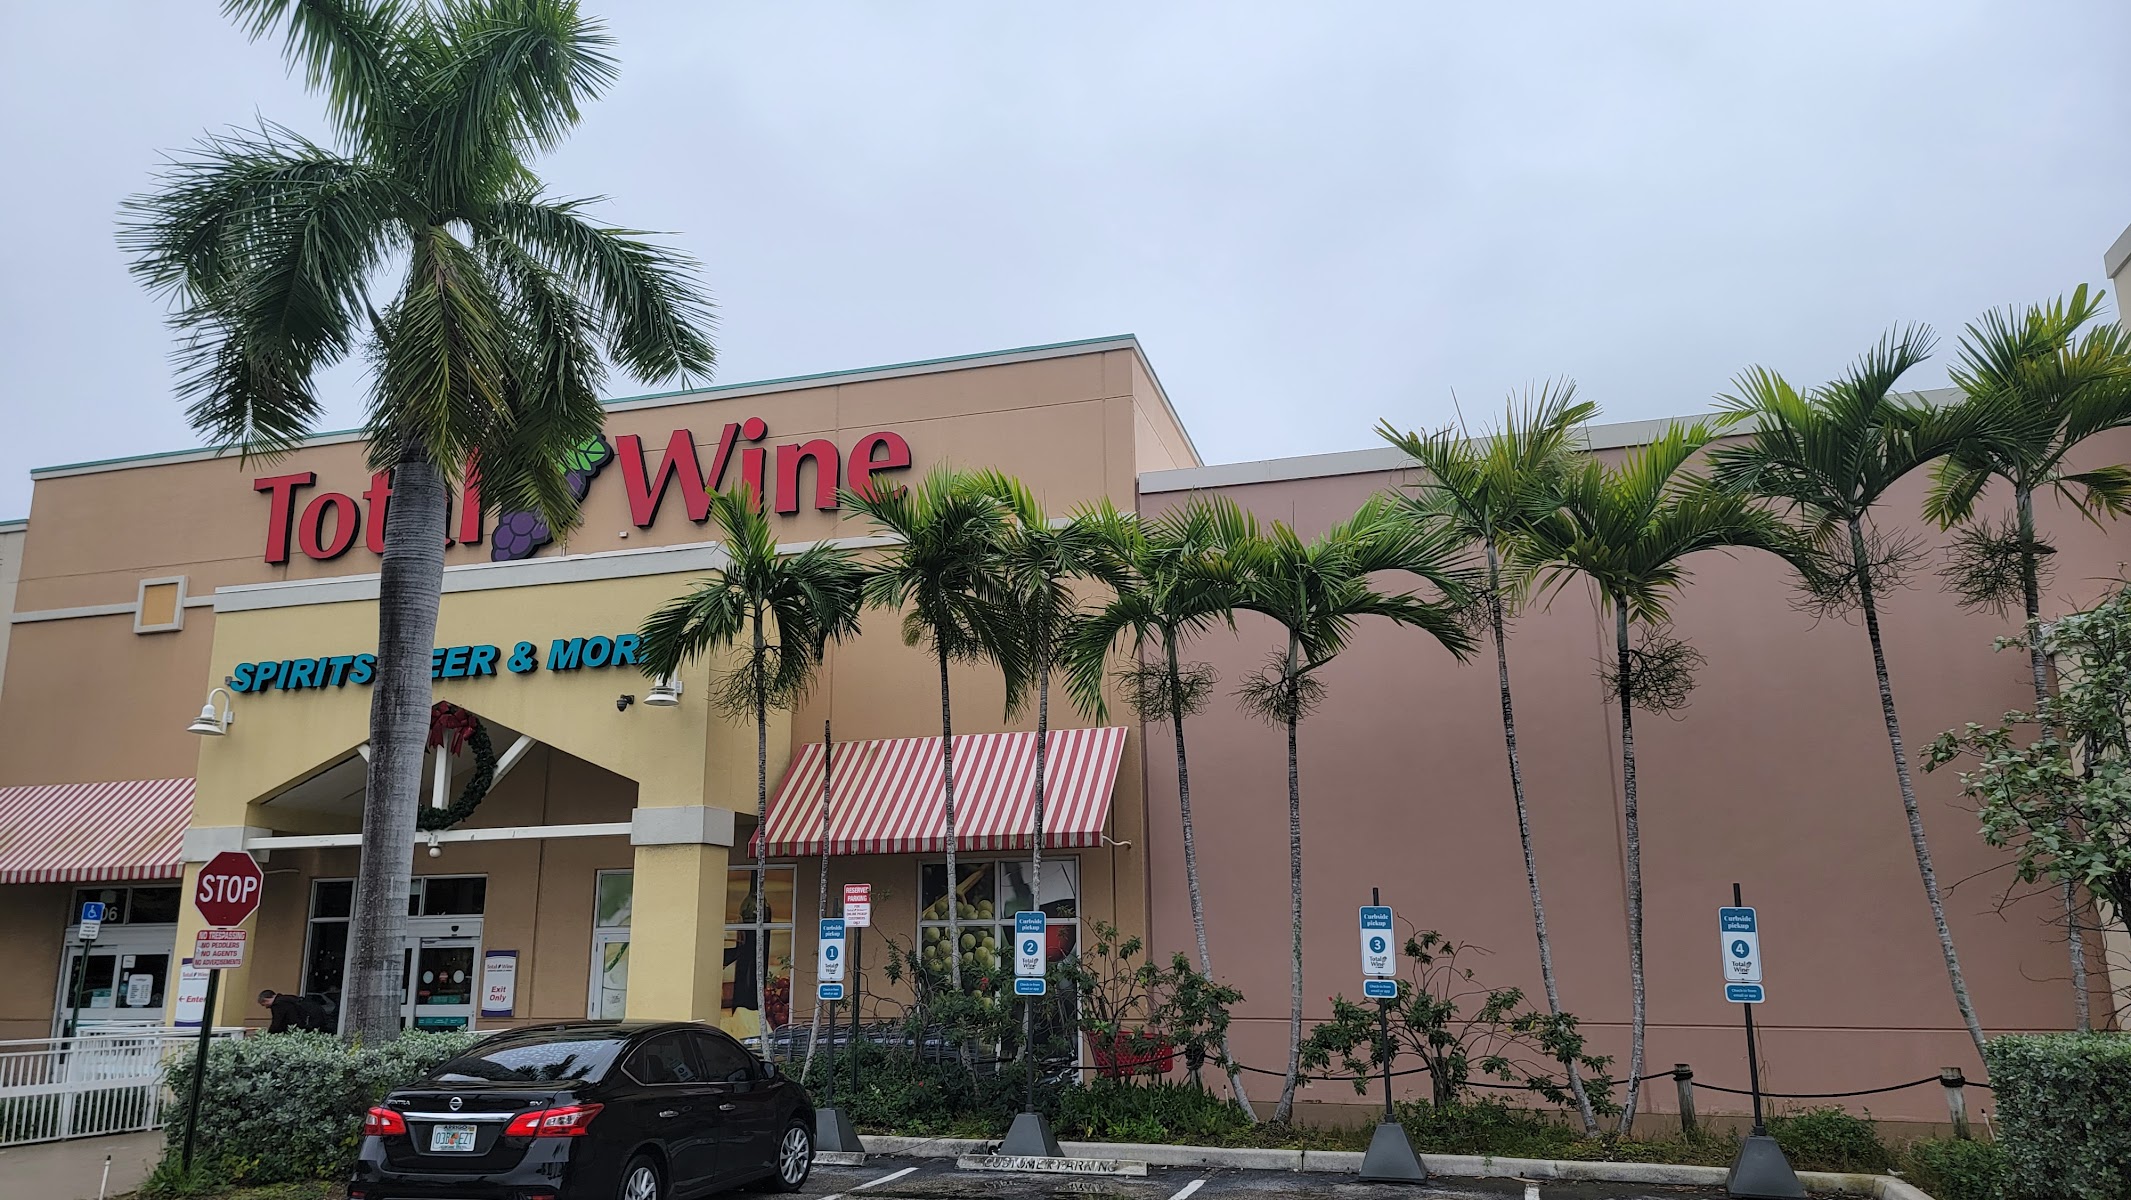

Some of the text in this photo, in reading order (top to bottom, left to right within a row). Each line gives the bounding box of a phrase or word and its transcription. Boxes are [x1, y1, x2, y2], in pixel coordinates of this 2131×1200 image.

[254, 417, 911, 563] Totl Wine
[230, 653, 376, 693] SPIRITS
[507, 641, 538, 673] &
[200, 874, 258, 904] STOP
[1027, 942, 1034, 952] 2
[1374, 939, 1381, 950] 3
[1736, 943, 1744, 954] 4
[830, 948, 835, 957] 1
[490, 994, 507, 1003] Only
[459, 1132, 474, 1145] EZT
